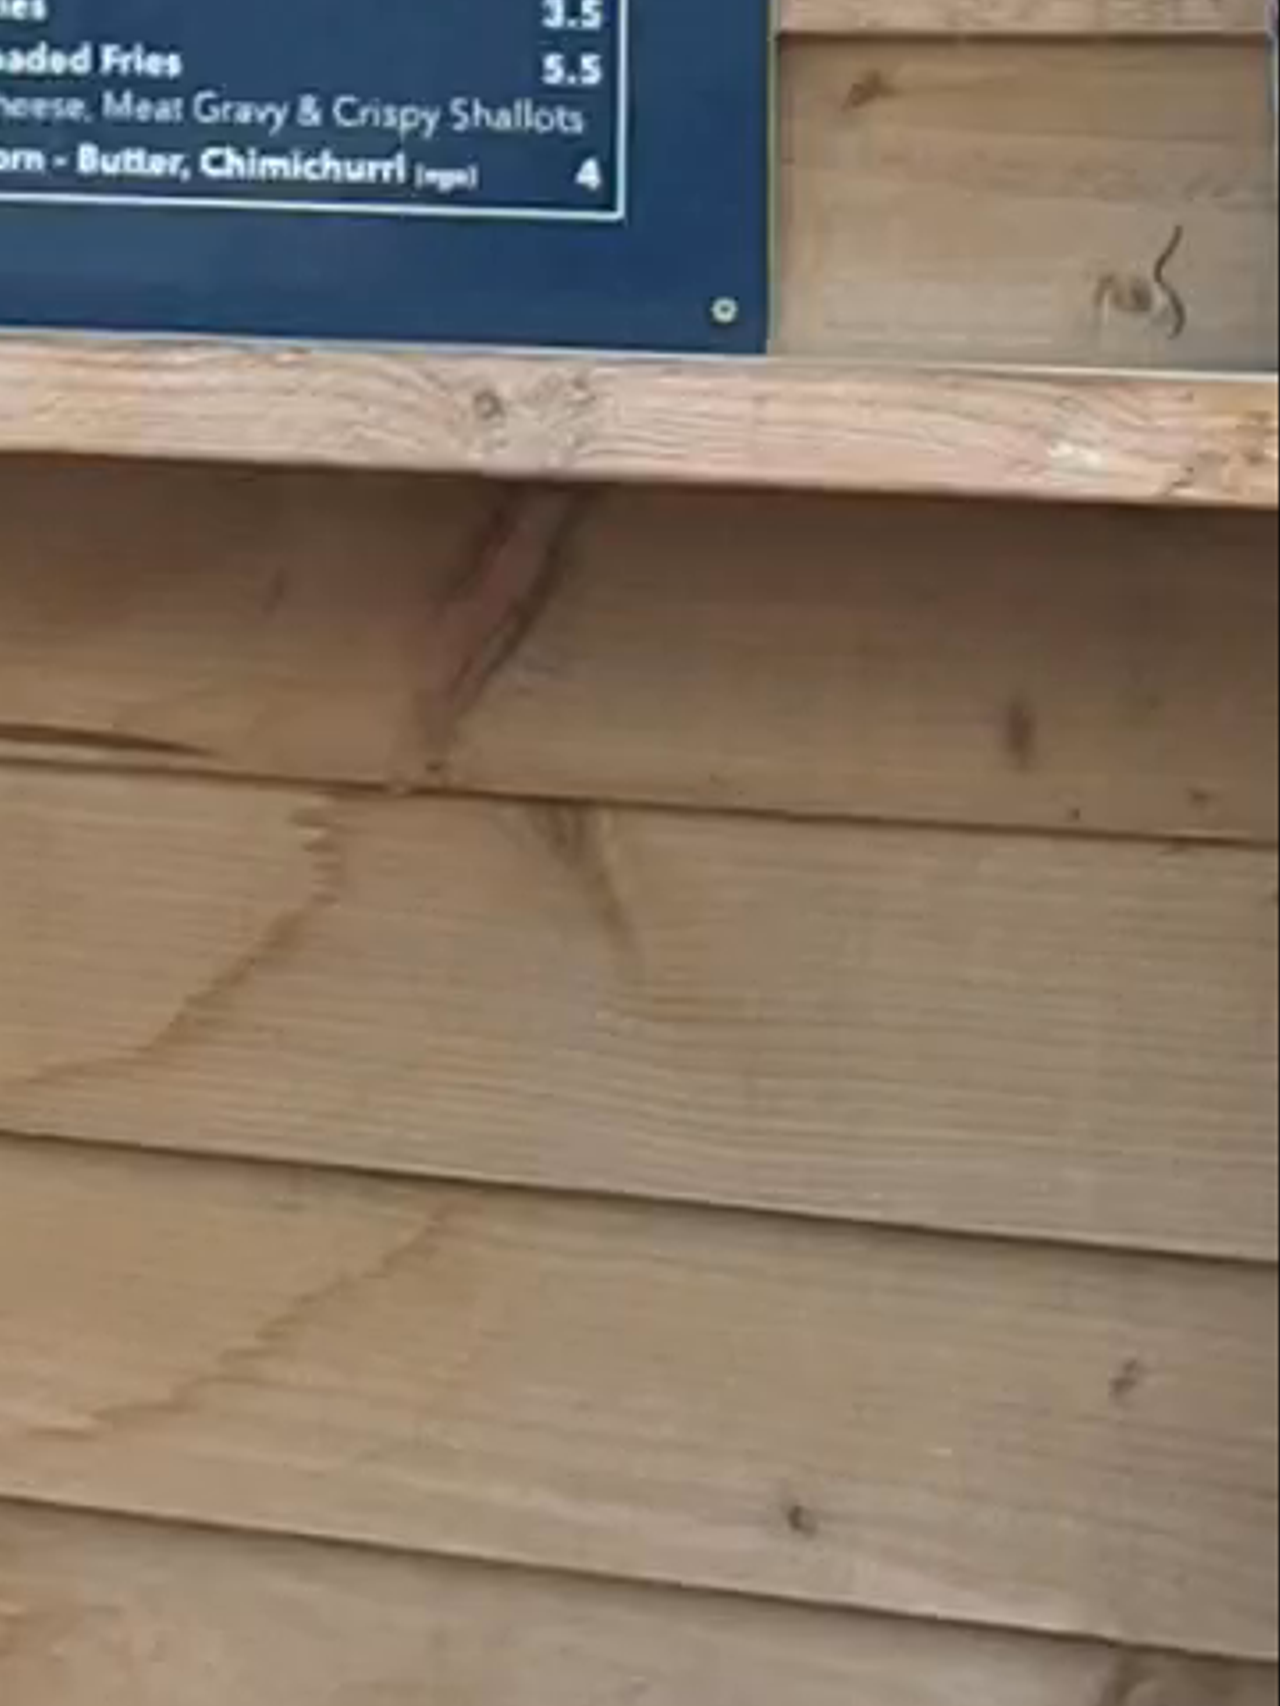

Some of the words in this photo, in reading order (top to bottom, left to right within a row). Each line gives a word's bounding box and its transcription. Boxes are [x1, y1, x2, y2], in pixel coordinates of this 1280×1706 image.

[100, 45, 183, 78] Fries
[541, 55, 602, 85] 5.5
[103, 93, 184, 123] Meat
[193, 92, 288, 133] Gravy
[297, 97, 321, 127] &
[332, 97, 441, 137] Crispy
[450, 100, 585, 135] Shallots
[200, 146, 404, 186] Chimichurri
[577, 159, 600, 189] 4
